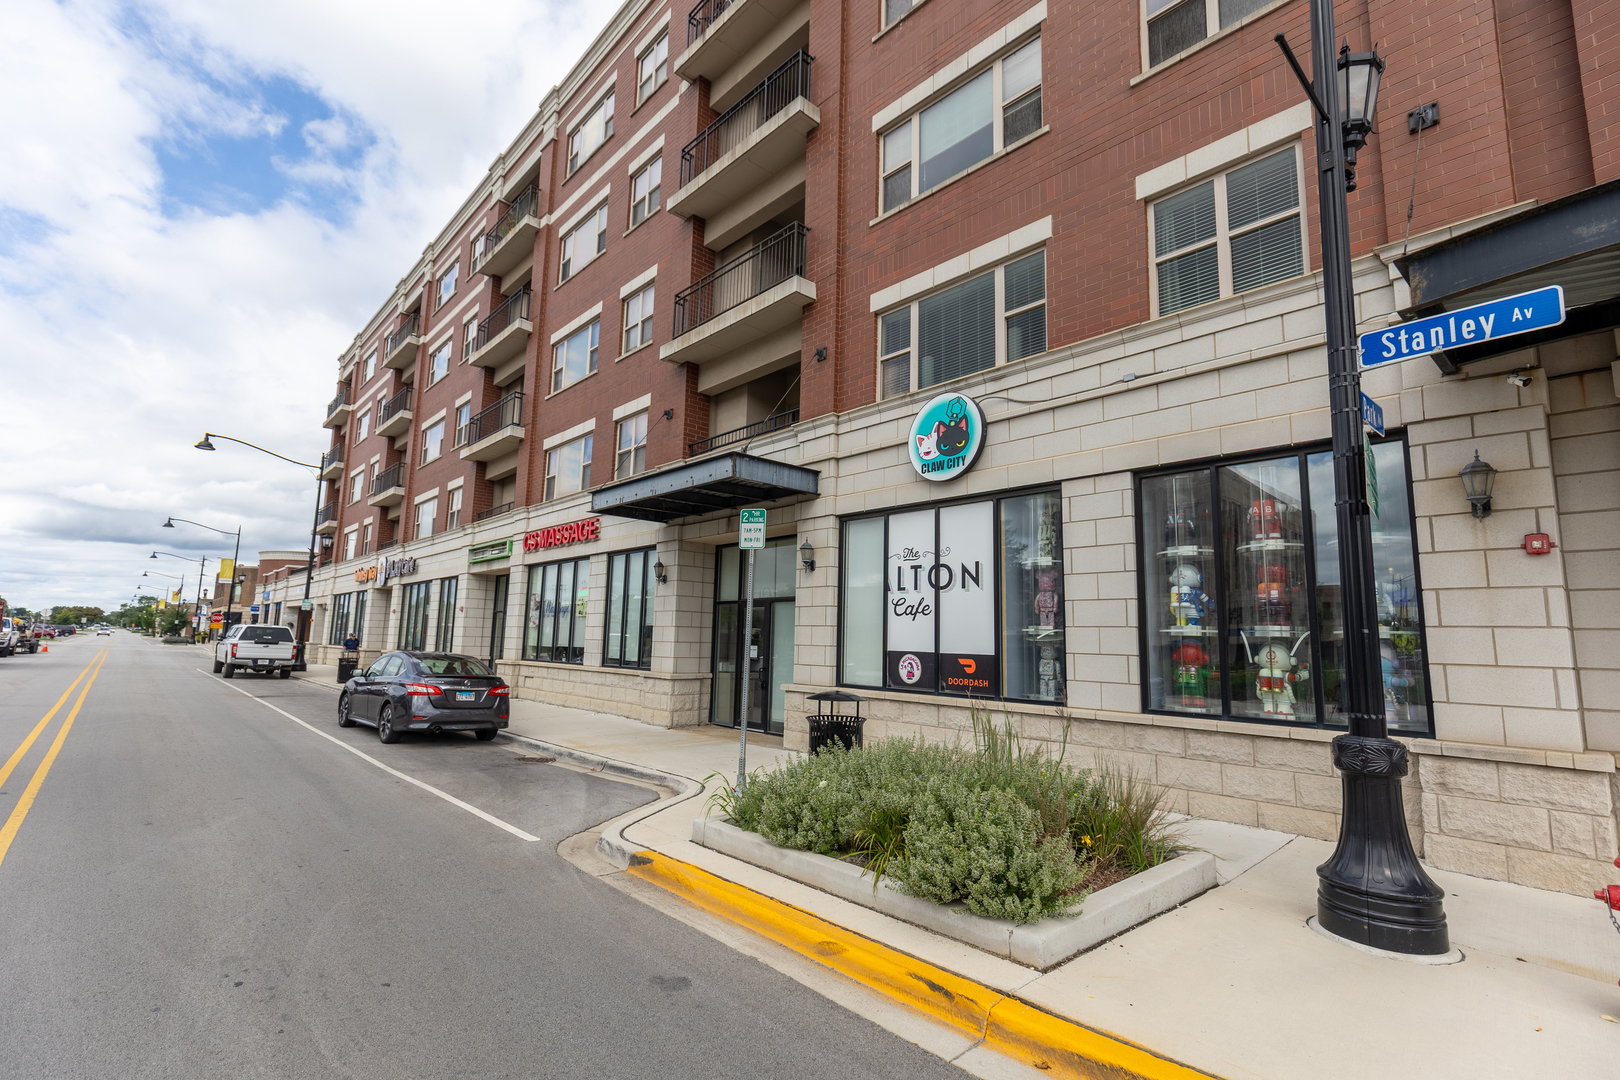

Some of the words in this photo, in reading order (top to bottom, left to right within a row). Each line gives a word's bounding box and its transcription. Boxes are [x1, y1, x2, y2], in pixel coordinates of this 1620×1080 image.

[1381, 313, 1495, 358] Stanley
[1512, 307, 1533, 322] Av
[921, 460, 945, 474] CLAW
[947, 455, 966, 469] CITY
[742, 512, 749, 522] 2
[1266, 505, 1272, 513] B
[523, 531, 539, 551] CS
[539, 518, 600, 548] MASSAGE
[903, 547, 920, 561] The
[545, 600, 570, 618] Maage
[892, 597, 932, 621] Cafe
[948, 677, 989, 688] DOORDASH
[1261, 677, 1266, 685] A
